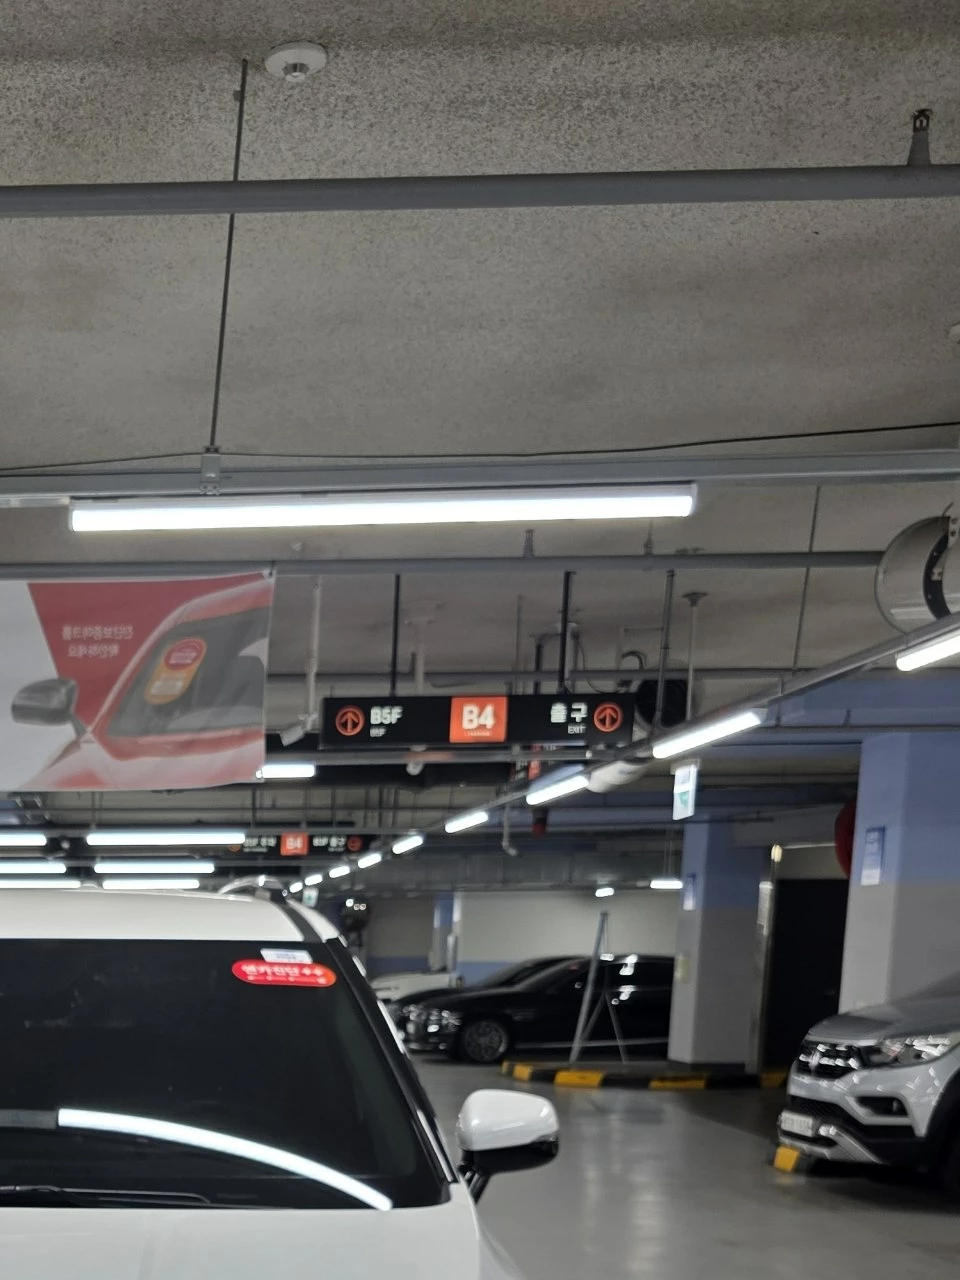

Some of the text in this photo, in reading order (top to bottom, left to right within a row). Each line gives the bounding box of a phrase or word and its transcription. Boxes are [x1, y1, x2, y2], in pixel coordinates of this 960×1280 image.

[370, 706, 403, 725] B5F
[462, 703, 496, 730] B4
[550, 702, 588, 723] 출구
